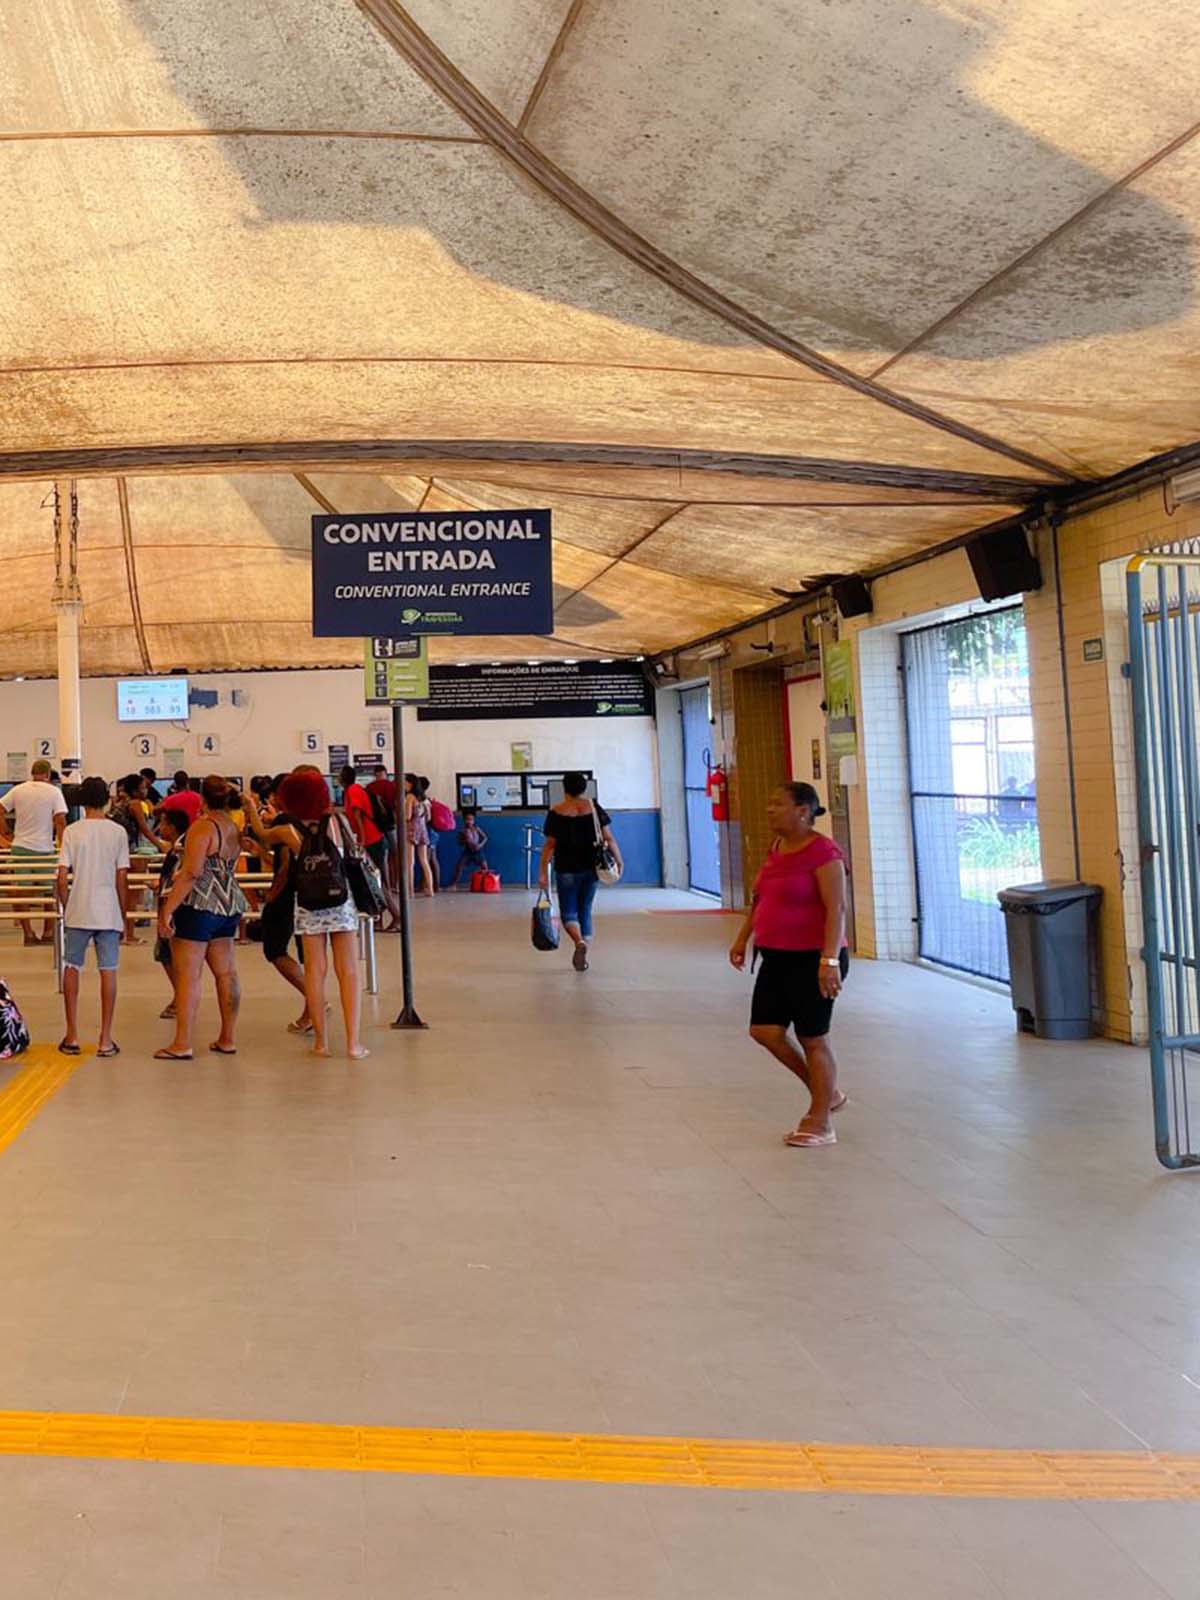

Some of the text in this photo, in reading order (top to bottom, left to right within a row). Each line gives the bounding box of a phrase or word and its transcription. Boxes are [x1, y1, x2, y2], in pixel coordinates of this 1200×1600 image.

[323, 519, 541, 544] CONVENCIONAL
[368, 549, 496, 572] ENTRADA
[335, 582, 531, 598] CONVENTIONAL ENTRANCE
[141, 739, 150, 754] 3
[204, 736, 213, 751] 4
[307, 734, 317, 750] 5
[376, 732, 385, 747] 6
[41, 740, 50, 756] 2
